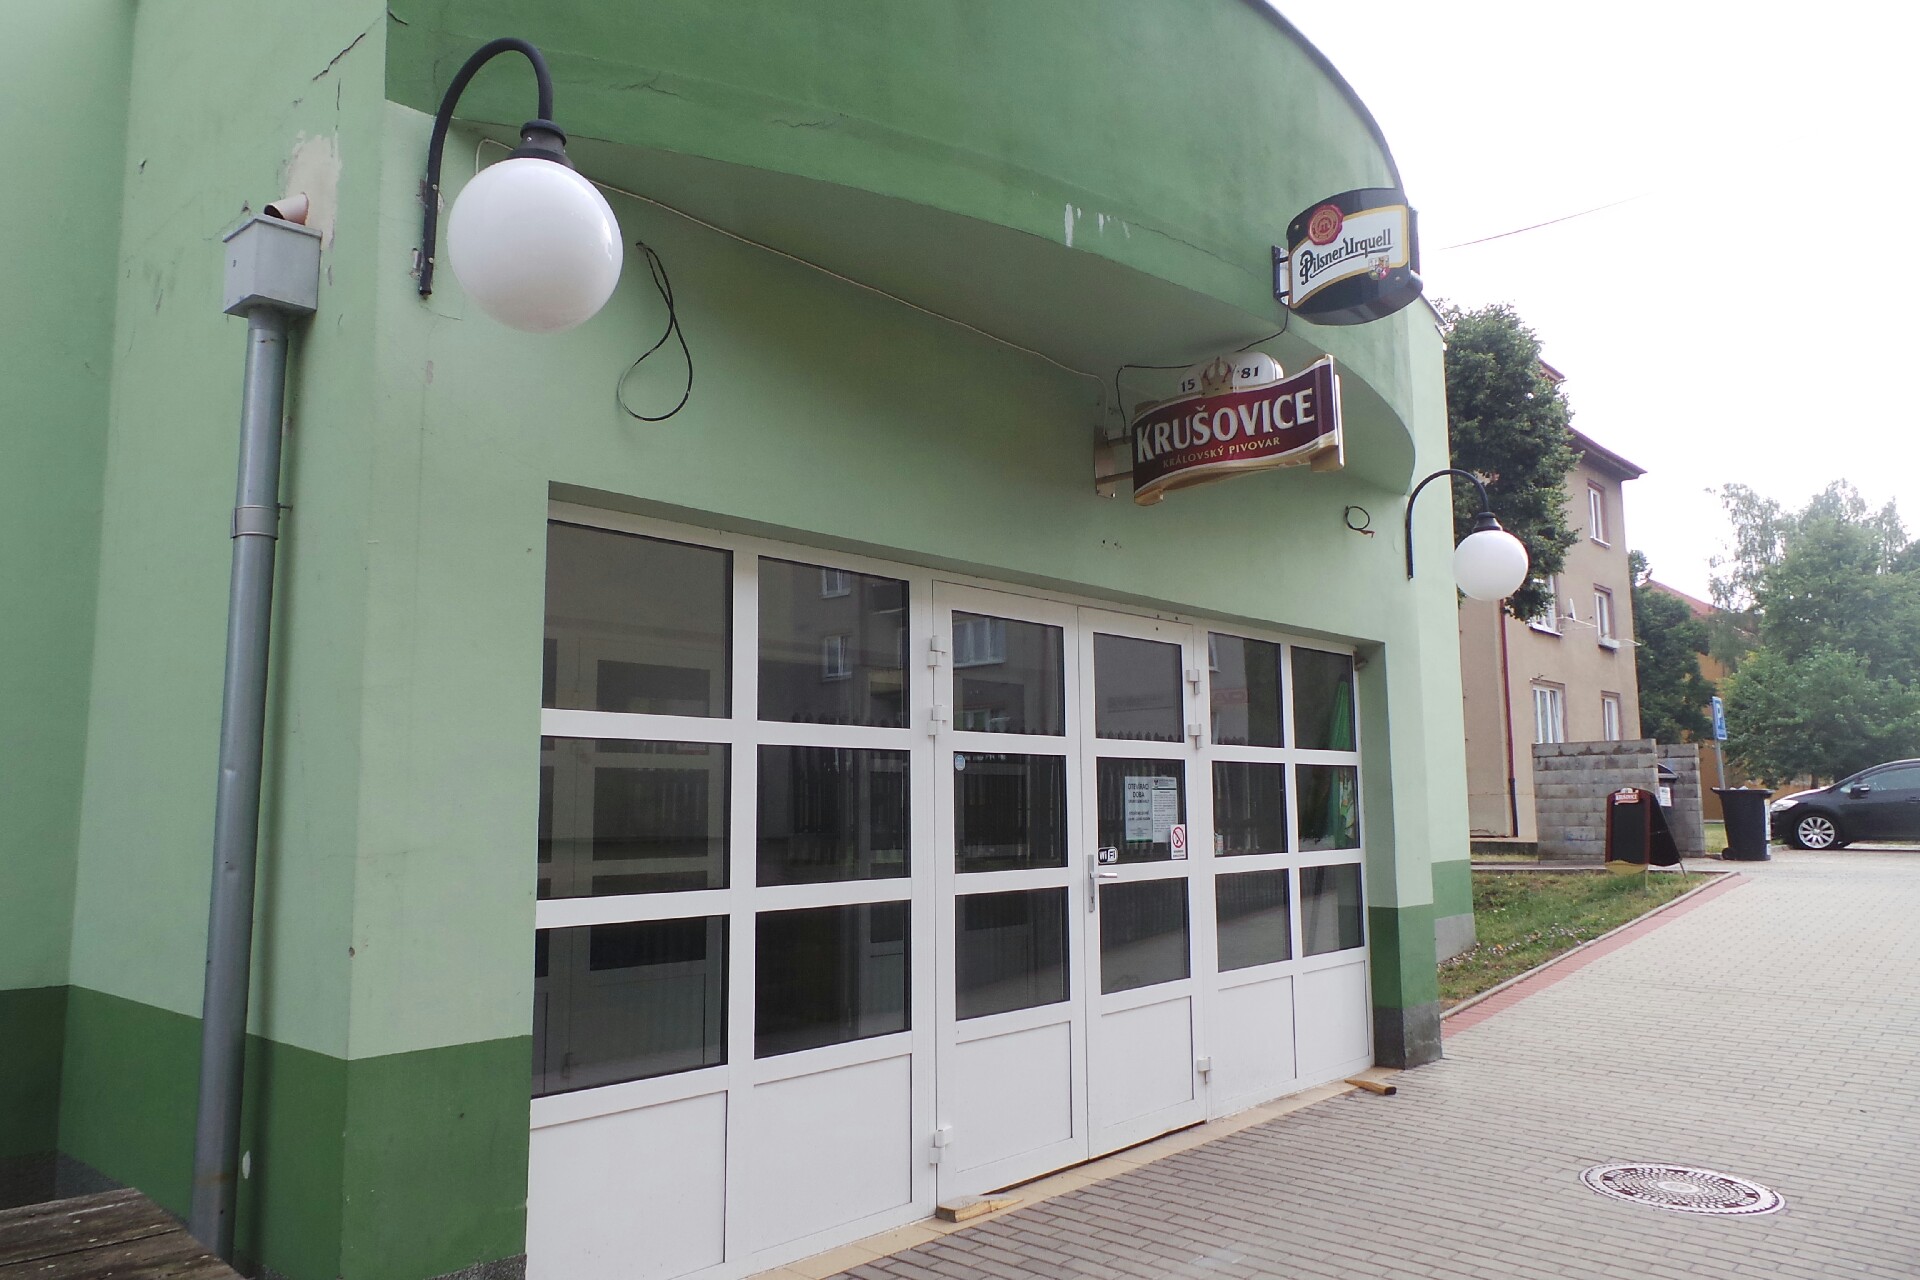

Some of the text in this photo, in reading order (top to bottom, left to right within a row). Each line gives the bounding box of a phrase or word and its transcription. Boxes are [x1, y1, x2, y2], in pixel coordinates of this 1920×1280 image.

[1300, 228, 1391, 285] Pilsner Urquell
[1181, 366, 1259, 393] 15 81
[1136, 388, 1315, 463] KRUŠOVICE
[1163, 436, 1281, 468] KRÁLOVSKÝ PIVOVAR
